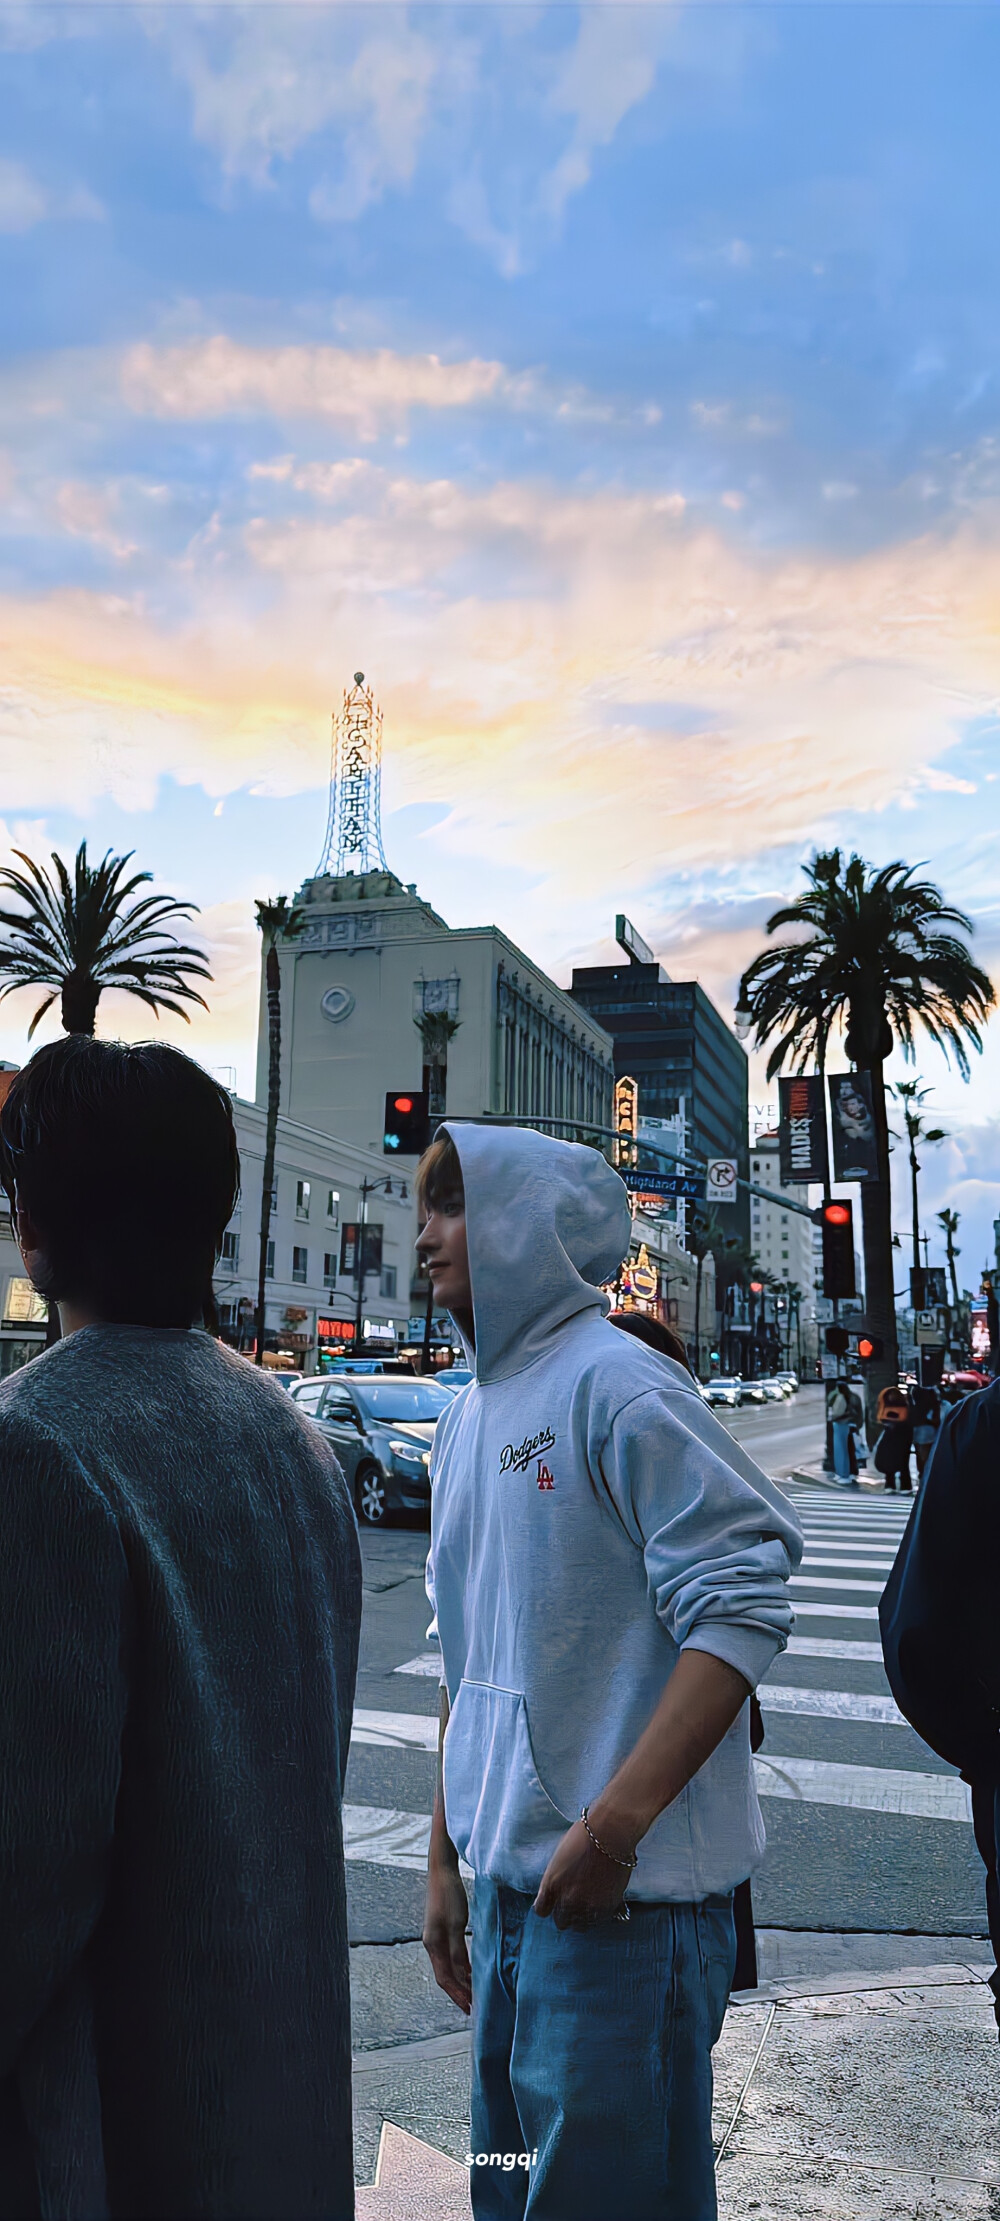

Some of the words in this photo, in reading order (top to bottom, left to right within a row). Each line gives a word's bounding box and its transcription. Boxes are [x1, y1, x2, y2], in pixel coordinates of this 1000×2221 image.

[626, 1175, 677, 1191] Highland
[499, 1425, 556, 1475] Dodgers
[536, 1459, 556, 1490] LA
